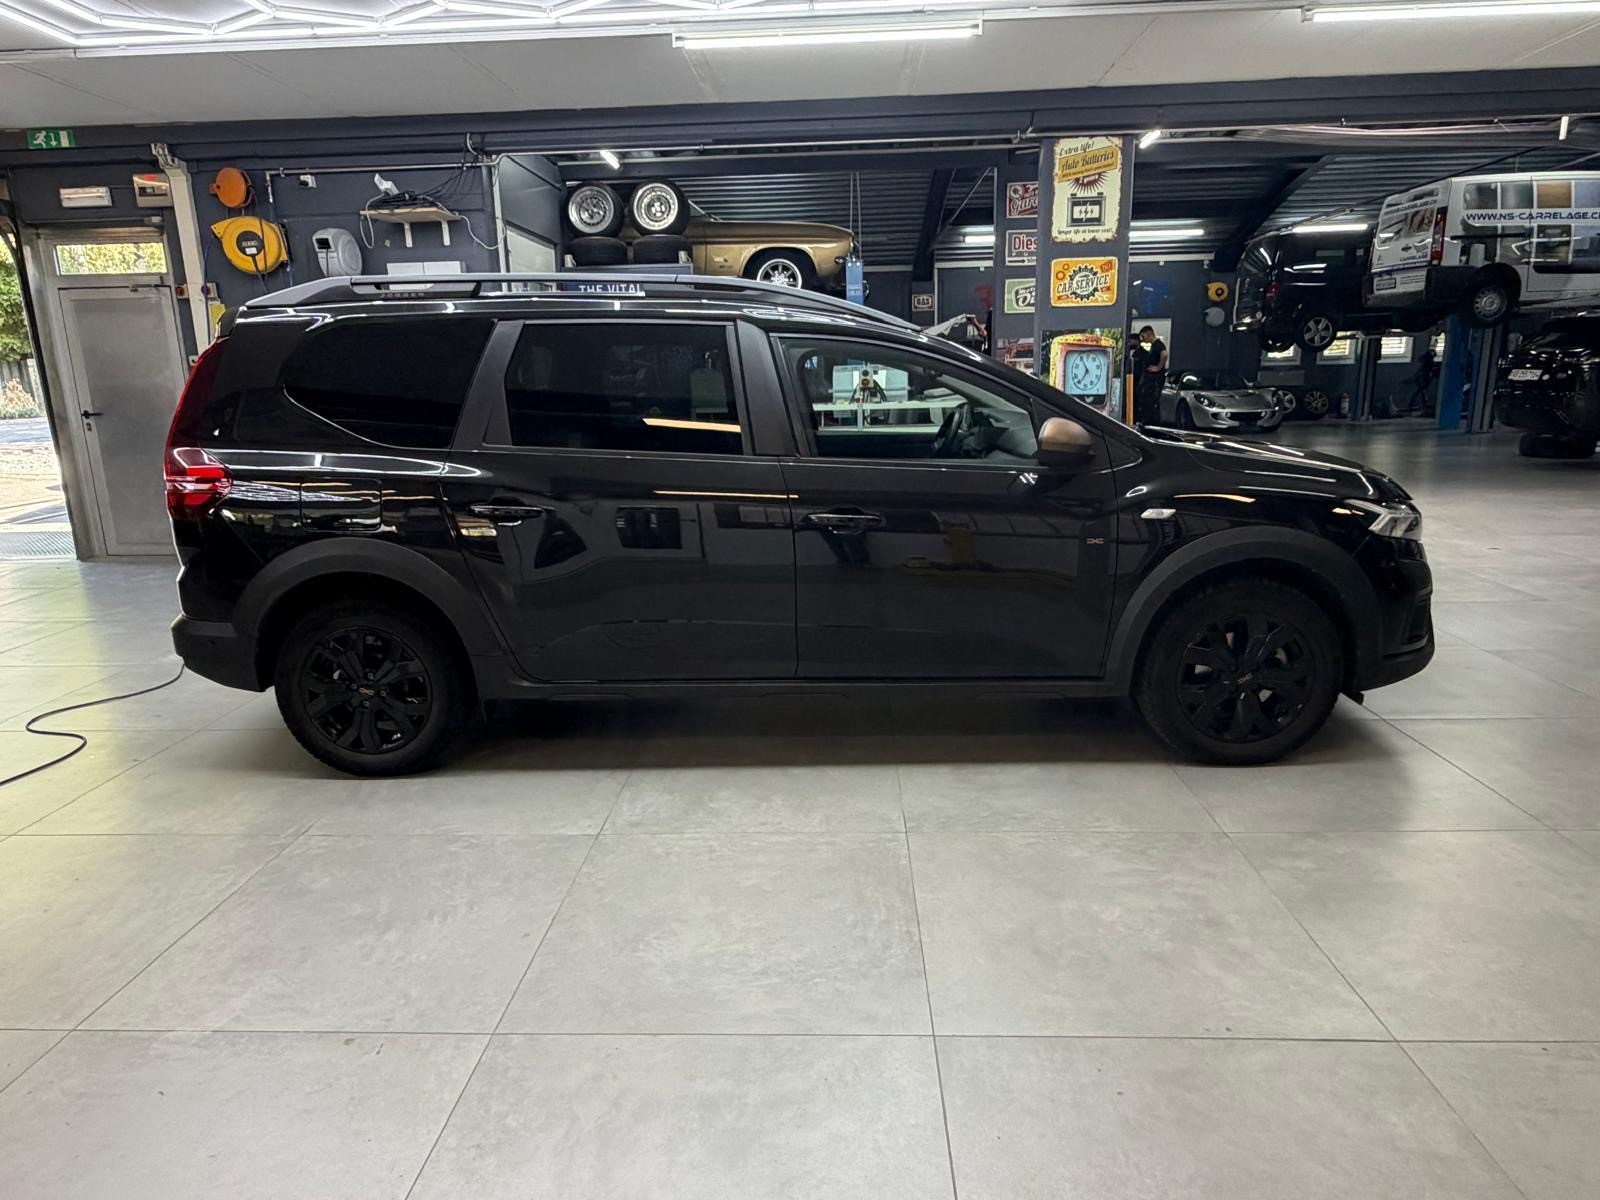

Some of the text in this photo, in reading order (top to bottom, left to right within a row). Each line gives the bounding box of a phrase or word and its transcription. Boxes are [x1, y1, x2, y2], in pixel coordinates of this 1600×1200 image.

[578, 284, 603, 293] THE
[1057, 273, 1110, 294] CAR SERVICE
